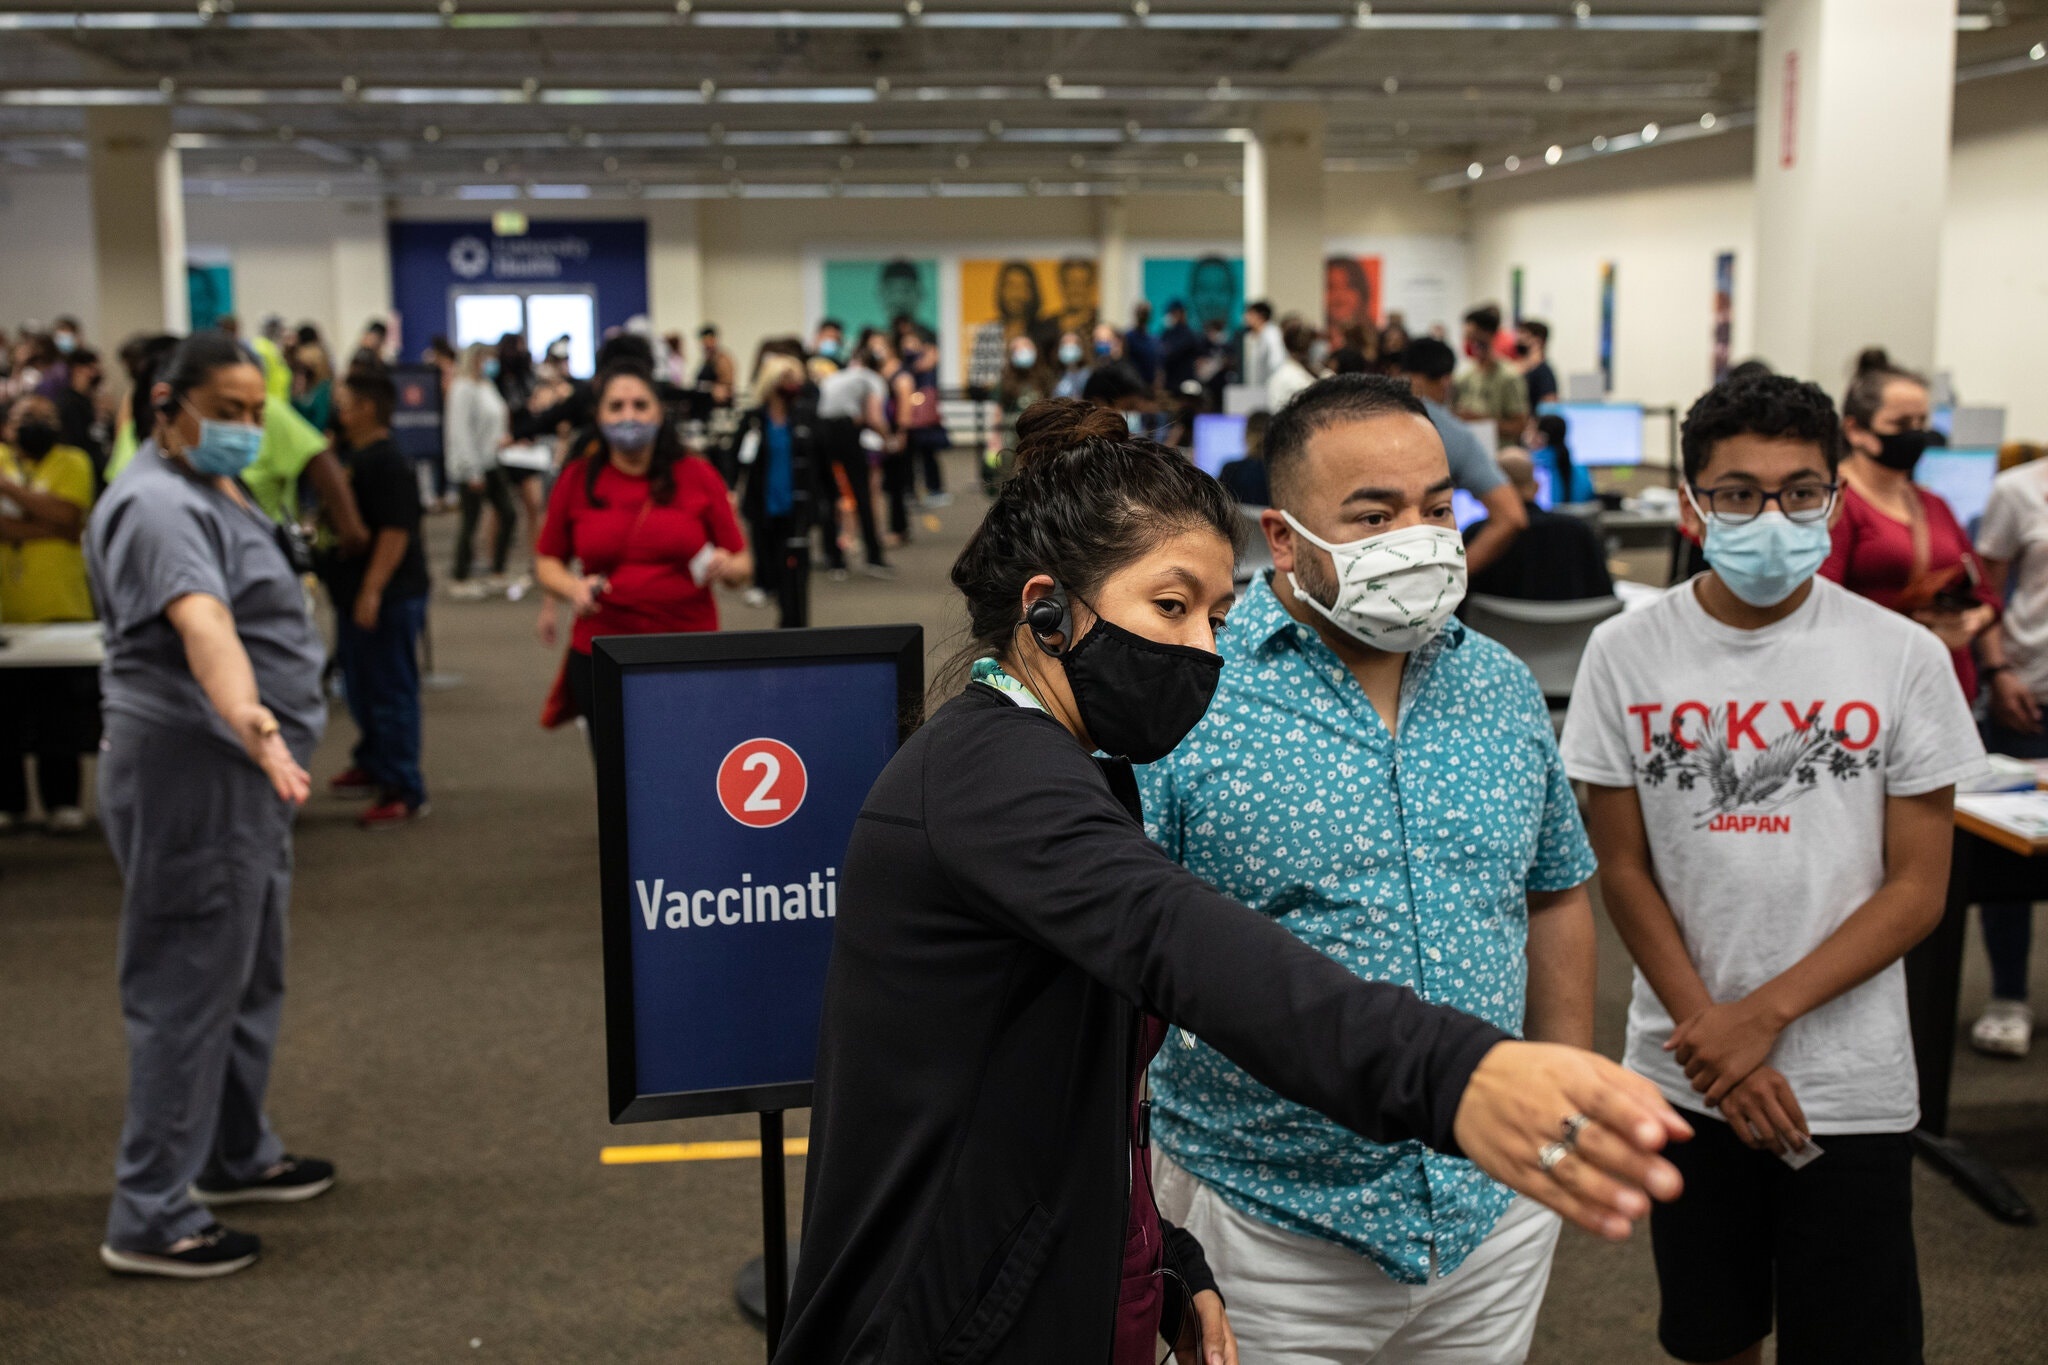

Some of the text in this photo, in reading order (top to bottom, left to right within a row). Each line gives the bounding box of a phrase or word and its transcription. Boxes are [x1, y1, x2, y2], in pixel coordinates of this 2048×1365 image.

[1628, 699, 1880, 754] TOKYO
[742, 751, 781, 812] 2
[1709, 815, 1790, 833] JAPAN
